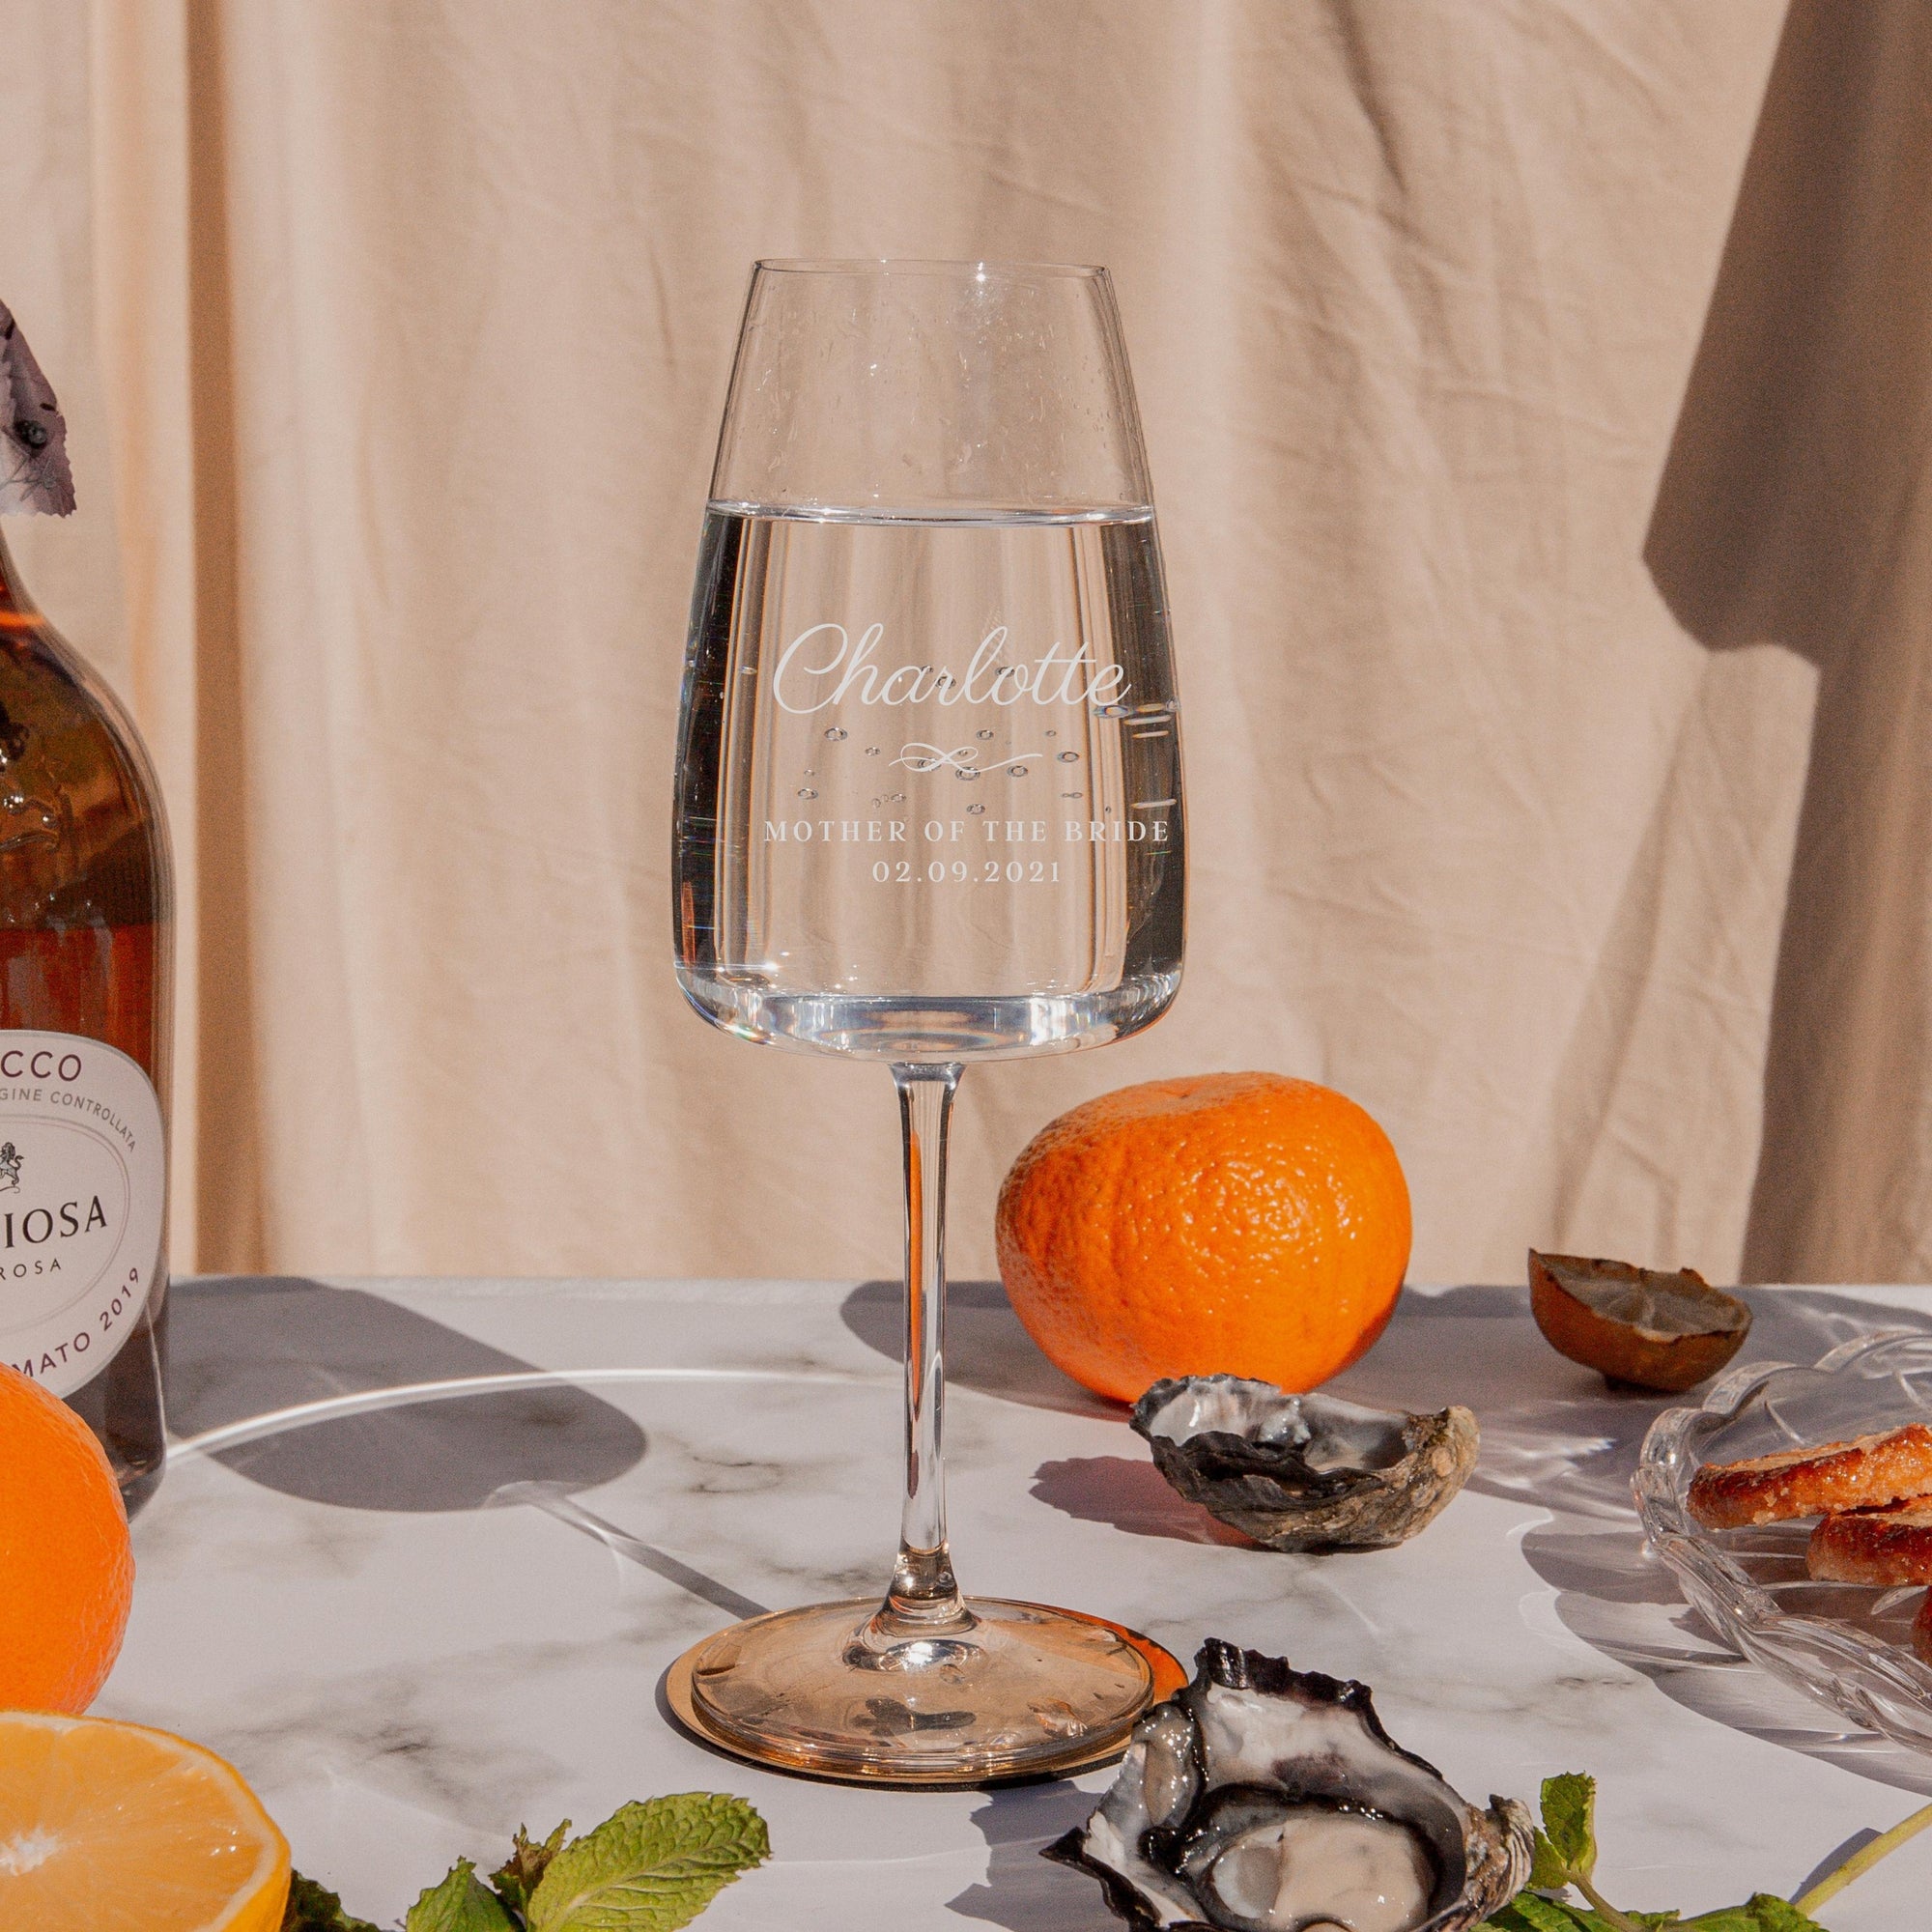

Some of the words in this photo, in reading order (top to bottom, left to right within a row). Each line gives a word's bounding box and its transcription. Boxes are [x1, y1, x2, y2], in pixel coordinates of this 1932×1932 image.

[771, 621, 1132, 715] Charlotte
[764, 819, 907, 843] MOTHER
[923, 819, 966, 843] OF
[985, 819, 1046, 843] THE
[1064, 819, 1170, 843] BRIDE
[871, 860, 1061, 884] 02.09.2021
[0, 1050, 82, 1082] CCO
[50, 1091, 137, 1152] CONTROLLATA
[4, 1195, 108, 1248] IOSA
[99, 1266, 139, 1332] 2019
